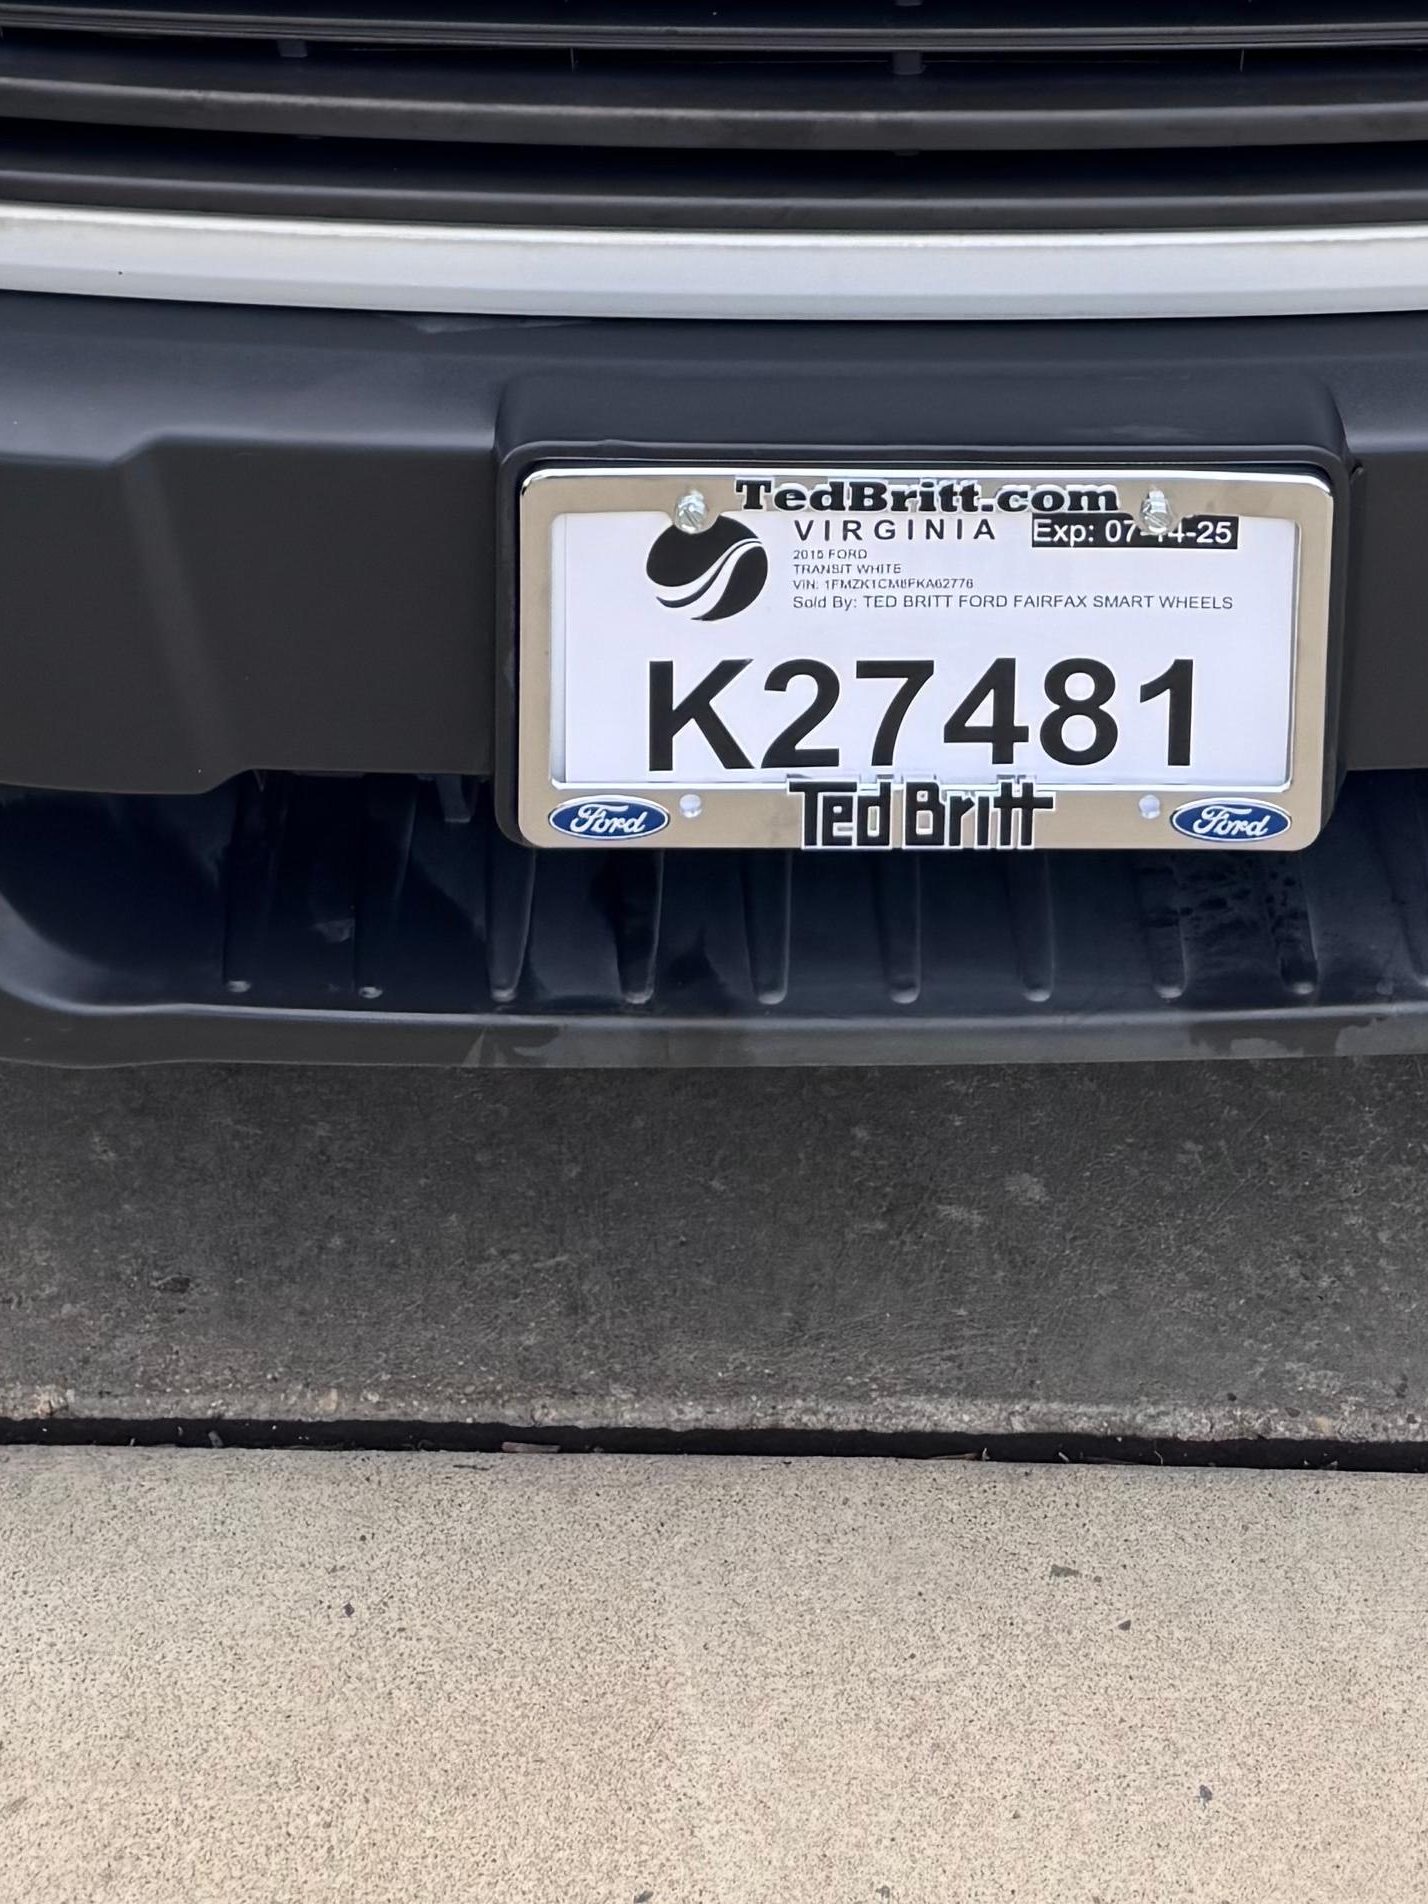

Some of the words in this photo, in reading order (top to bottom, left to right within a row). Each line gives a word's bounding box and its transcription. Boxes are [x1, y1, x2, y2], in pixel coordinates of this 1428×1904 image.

[734, 479, 1121, 513] TedBritt.com
[793, 518, 996, 541] VIRGINIA
[1033, 519, 1095, 547] Exp:
[828, 549, 868, 560] FORD
[793, 564, 853, 574] TRANSIT
[857, 564, 901, 574] WHITE
[793, 595, 827, 609] Sold
[832, 595, 857, 612] By:
[863, 595, 897, 608] TED
[903, 595, 953, 608] BRITT
[958, 595, 1008, 608] FORD
[1013, 595, 1087, 608] FAIRFAX
[1092, 595, 1154, 609] SMART
[1160, 596, 1233, 610] WHEELS
[648, 657, 1194, 772] K27481
[569, 803, 649, 833] Ford
[1192, 805, 1272, 836] Ford
